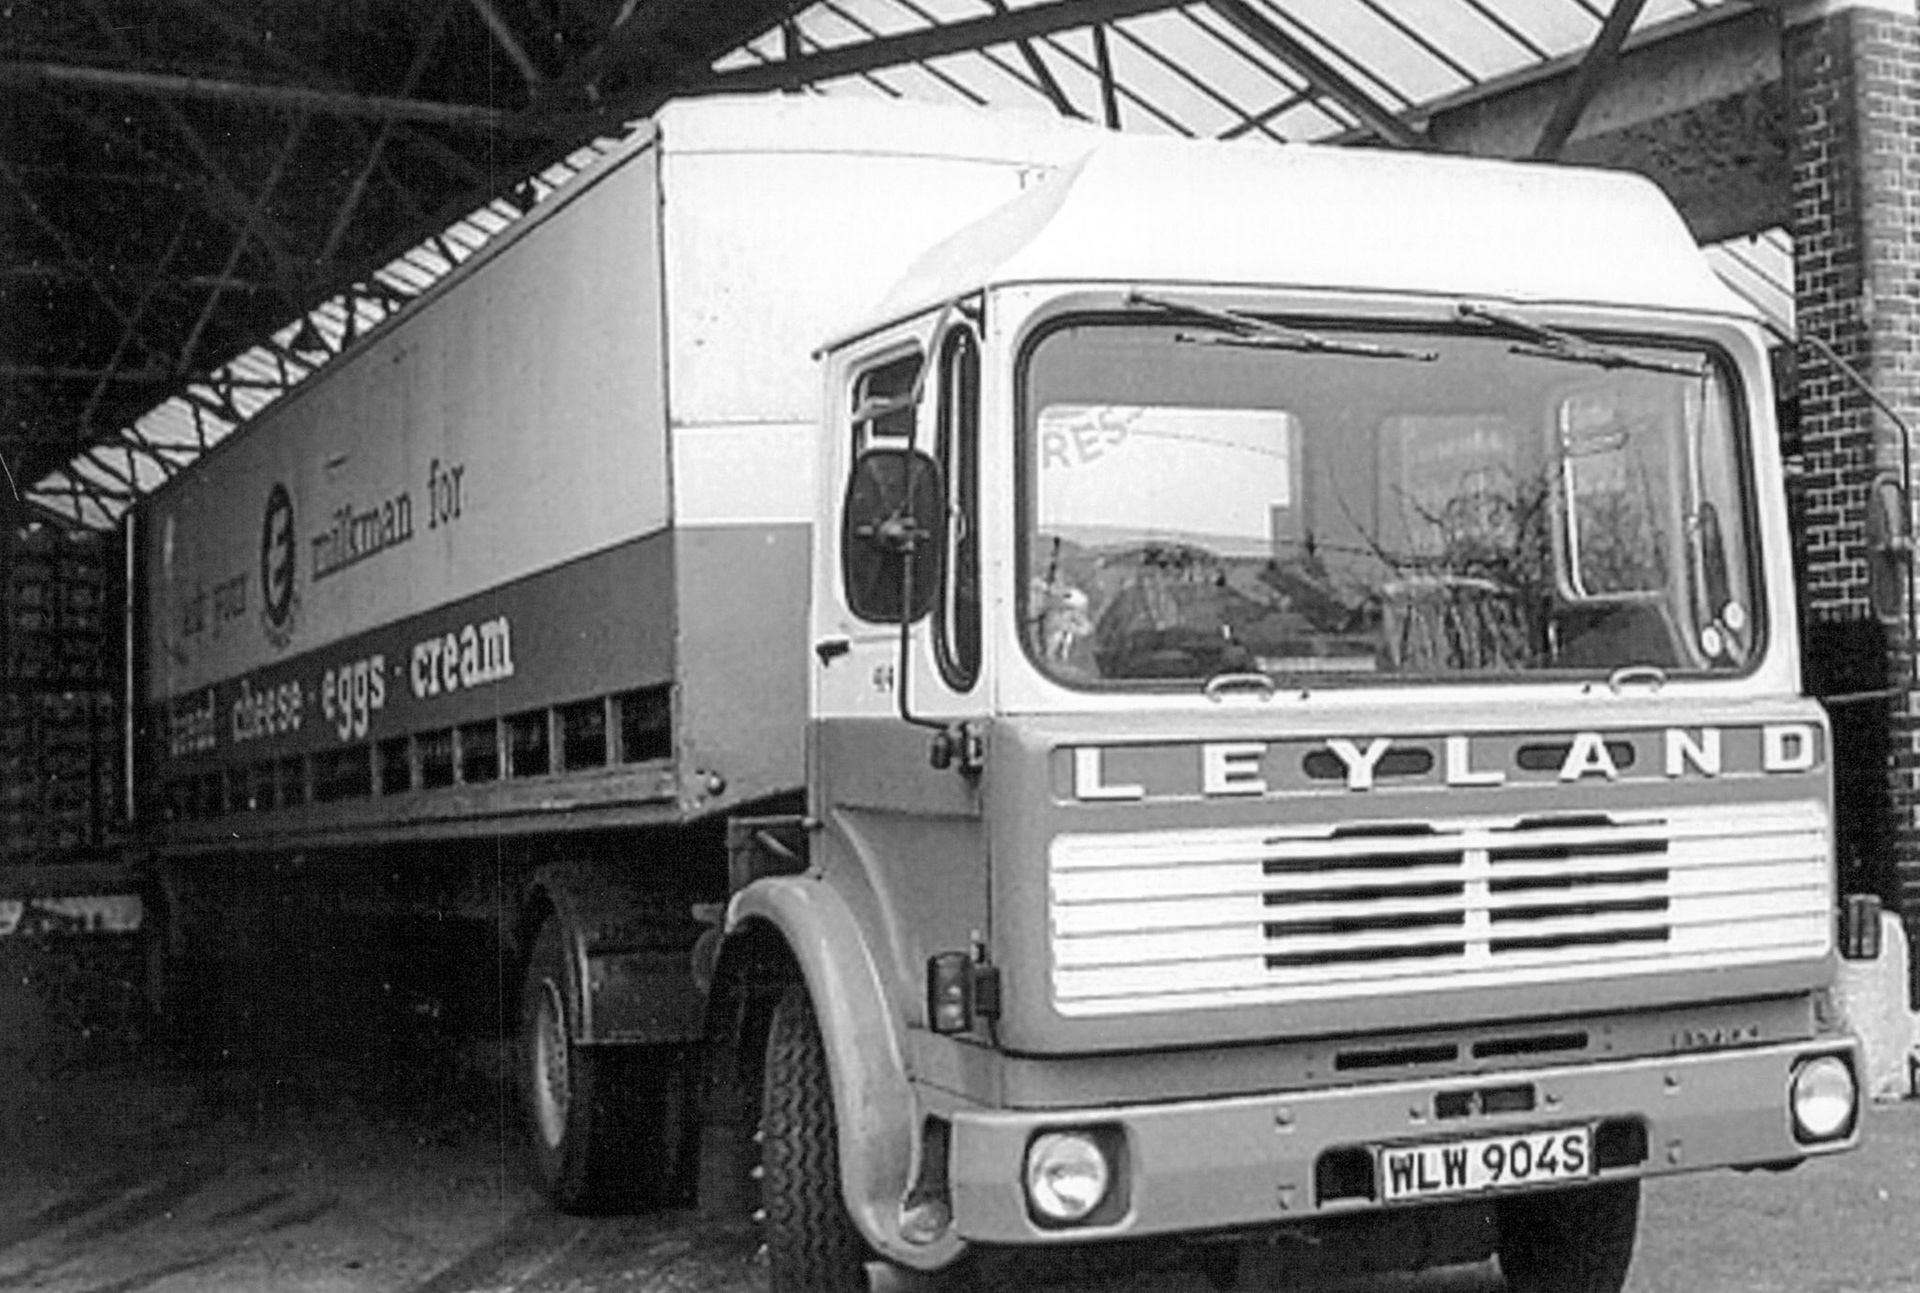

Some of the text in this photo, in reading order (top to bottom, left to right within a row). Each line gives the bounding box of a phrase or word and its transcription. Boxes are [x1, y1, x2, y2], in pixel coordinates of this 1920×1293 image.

[427, 458, 464, 529] for
[321, 654, 384, 742] eggs
[411, 616, 514, 698] cream
[1074, 725, 1814, 799] LEYLAND
[1389, 1135, 1585, 1195] WLW 904S
